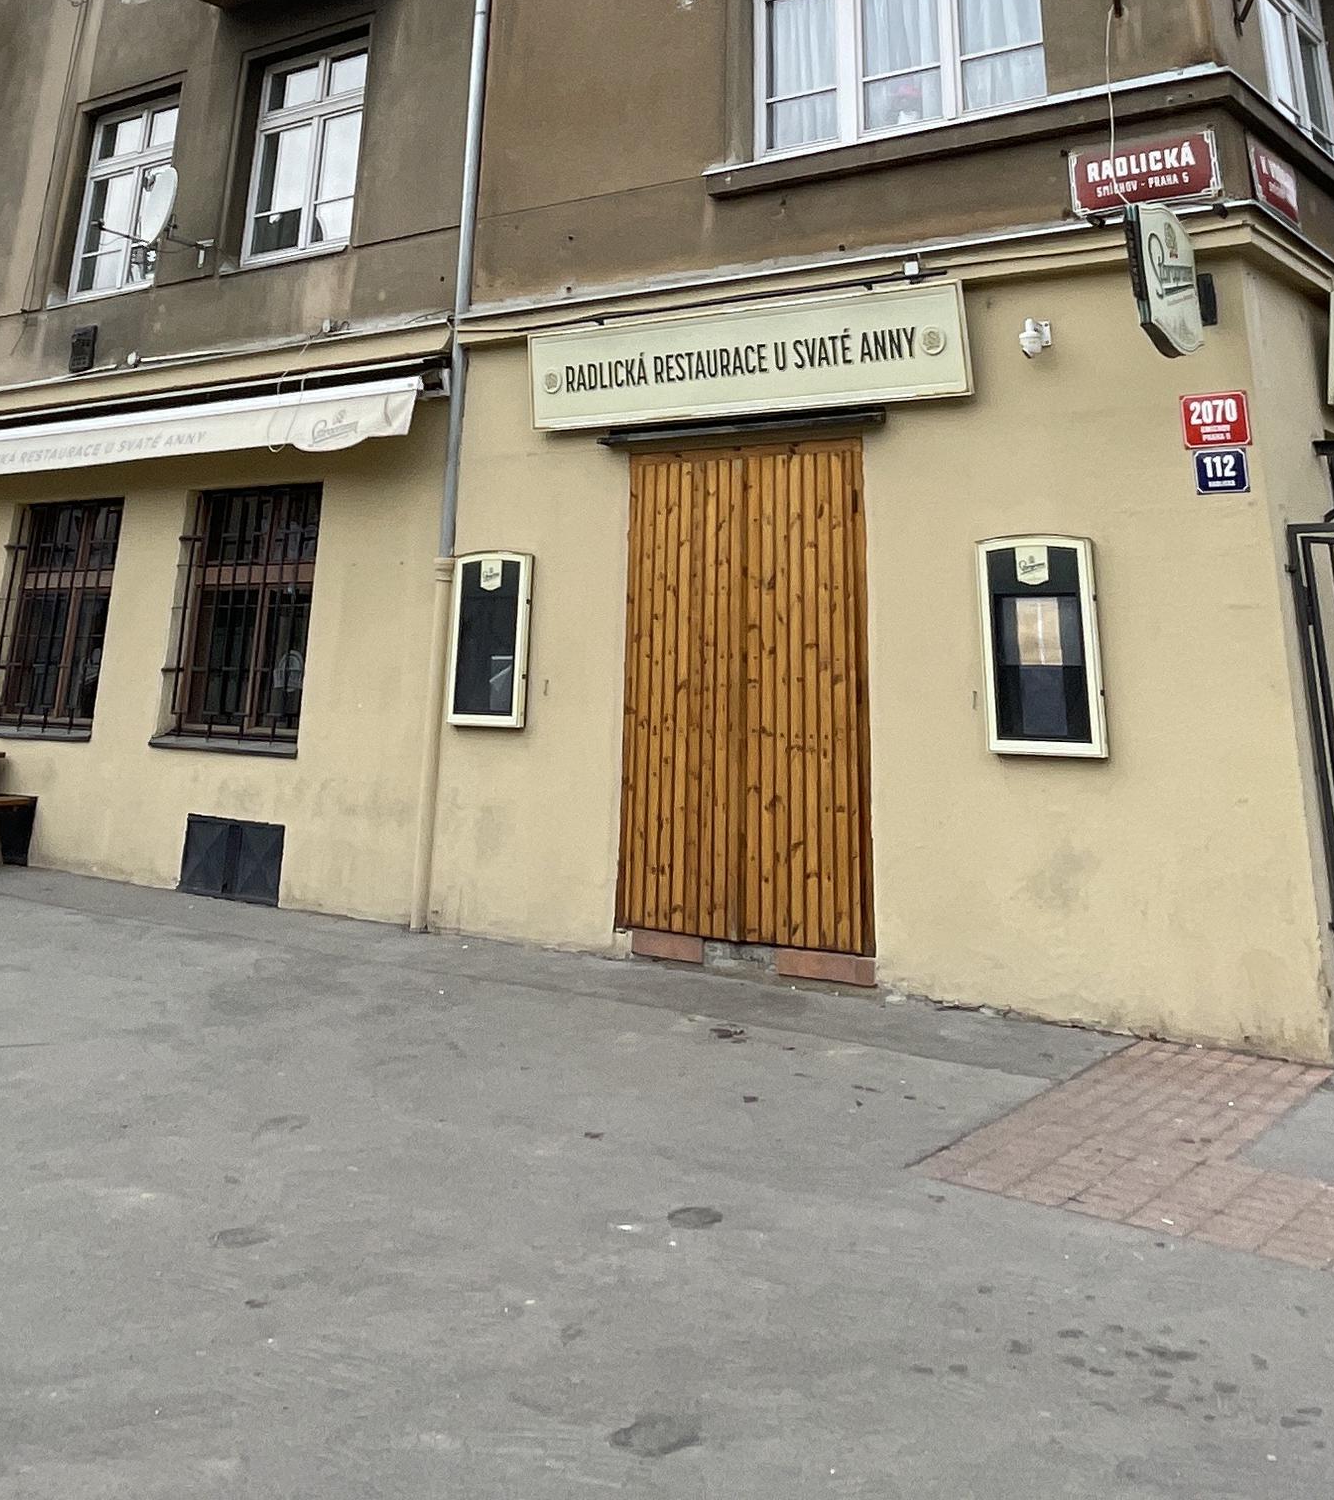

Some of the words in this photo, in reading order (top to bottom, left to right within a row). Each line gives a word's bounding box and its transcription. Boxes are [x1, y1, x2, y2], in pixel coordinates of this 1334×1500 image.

[1087, 142, 1196, 183] RADLICKÁ
[1148, 173, 1179, 188] PRAHA
[565, 352, 648, 393] RADLICKÁ
[653, 343, 768, 385] RESTAURACE
[773, 342, 787, 371] U
[792, 328, 853, 369] SVATÉ
[860, 327, 916, 364] ANNY
[1189, 398, 1238, 425] 2070
[1203, 454, 1236, 478] 112
